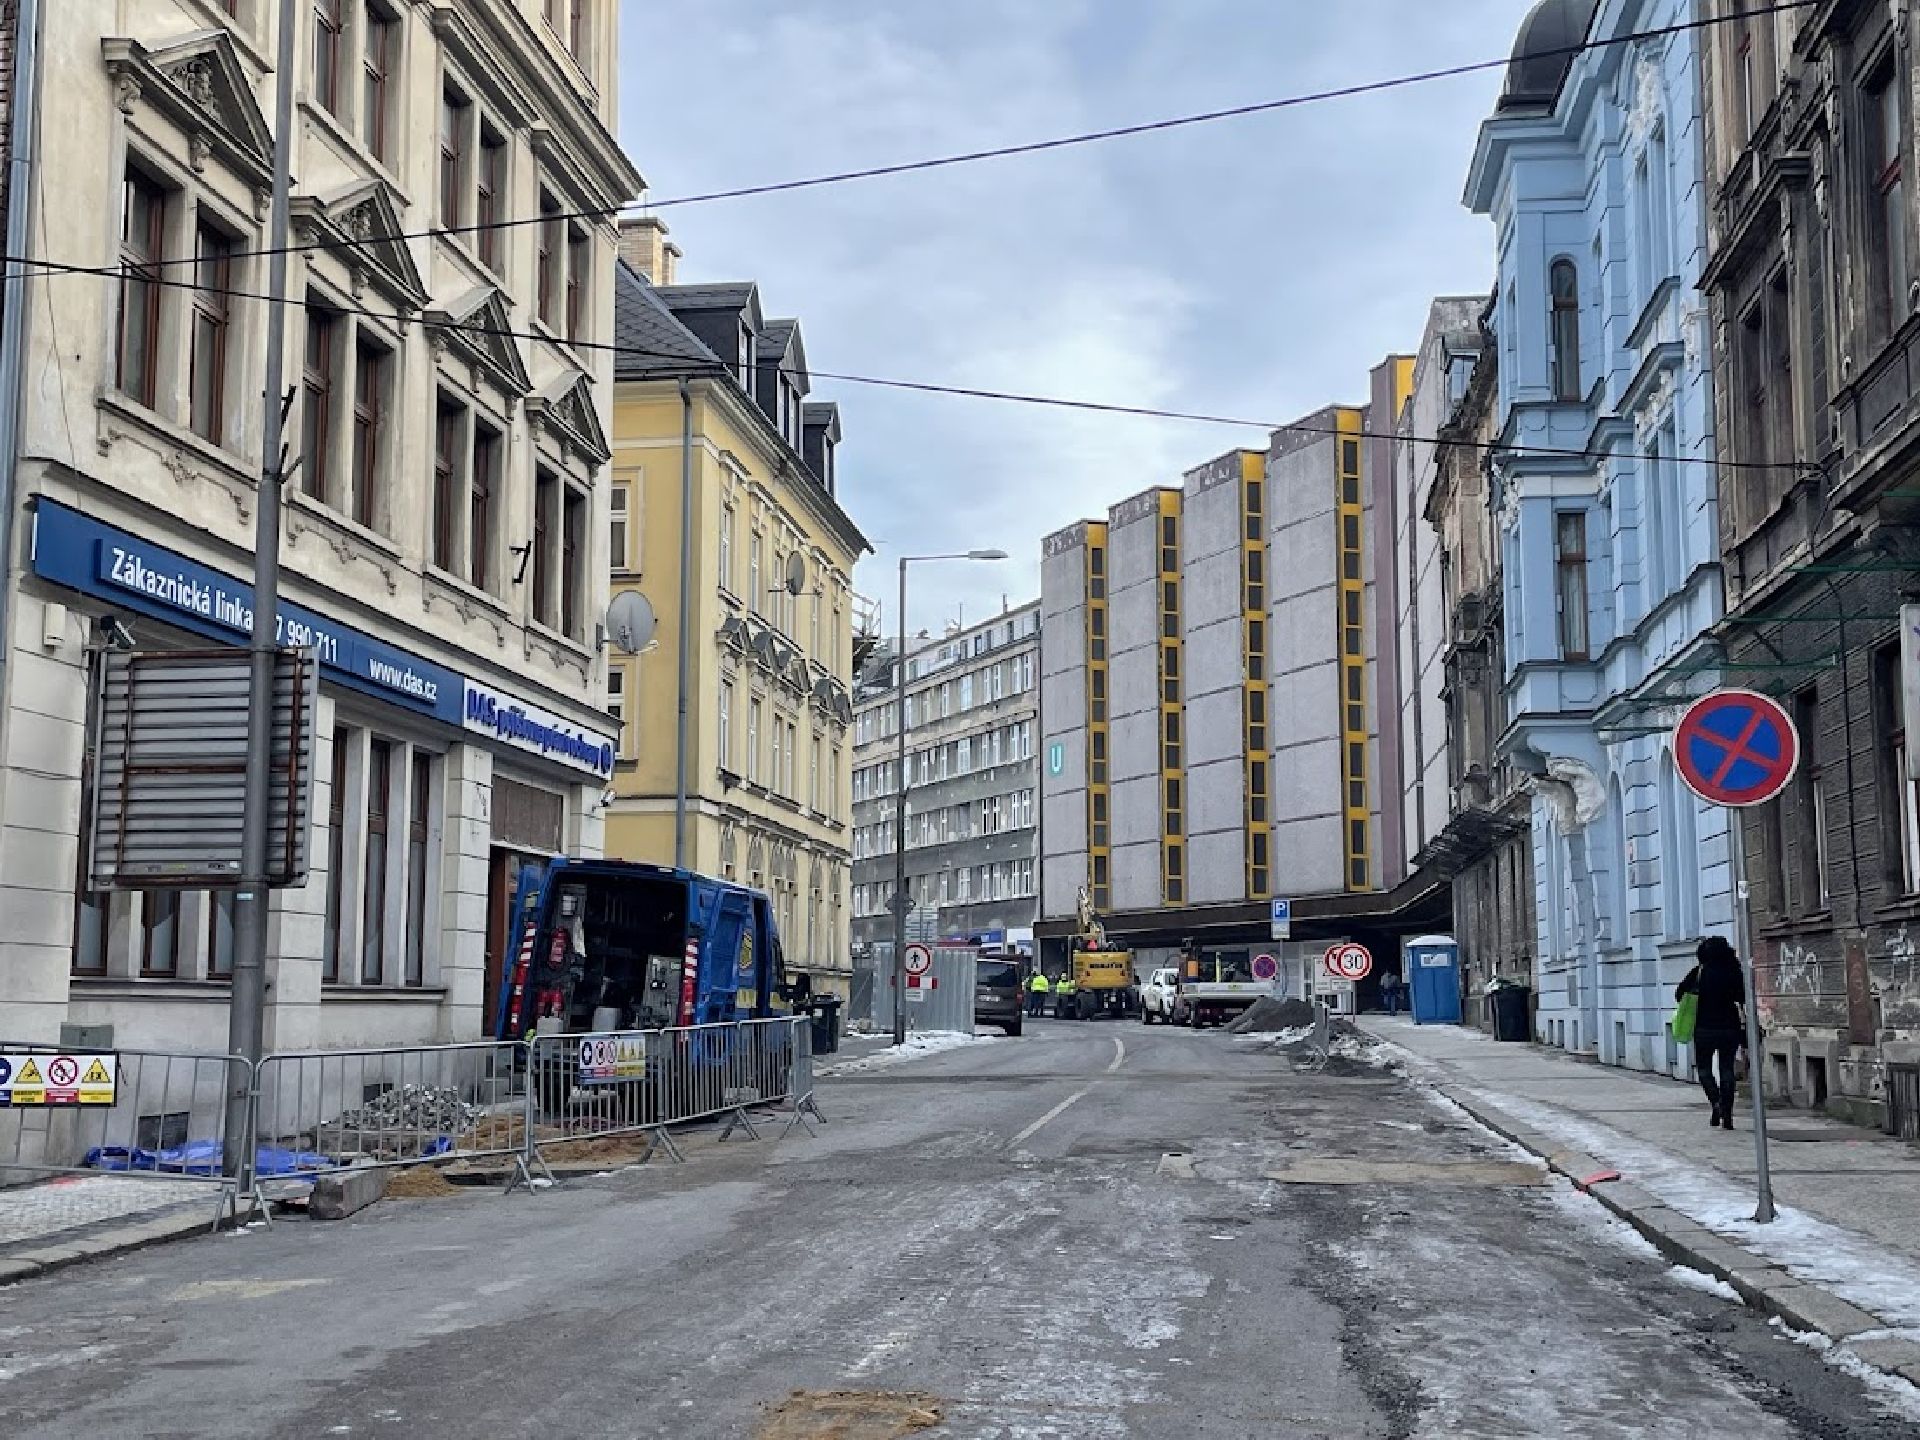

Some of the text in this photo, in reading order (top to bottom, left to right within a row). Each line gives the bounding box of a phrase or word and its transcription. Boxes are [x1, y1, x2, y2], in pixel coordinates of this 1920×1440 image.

[111, 547, 210, 616] Zákaznická
[215, 590, 254, 632] linka
[287, 620, 312, 647] 990
[315, 631, 337, 663] 711
[369, 658, 437, 701] www.das.cz
[1275, 901, 1286, 916] P
[1343, 953, 1364, 970] 30
